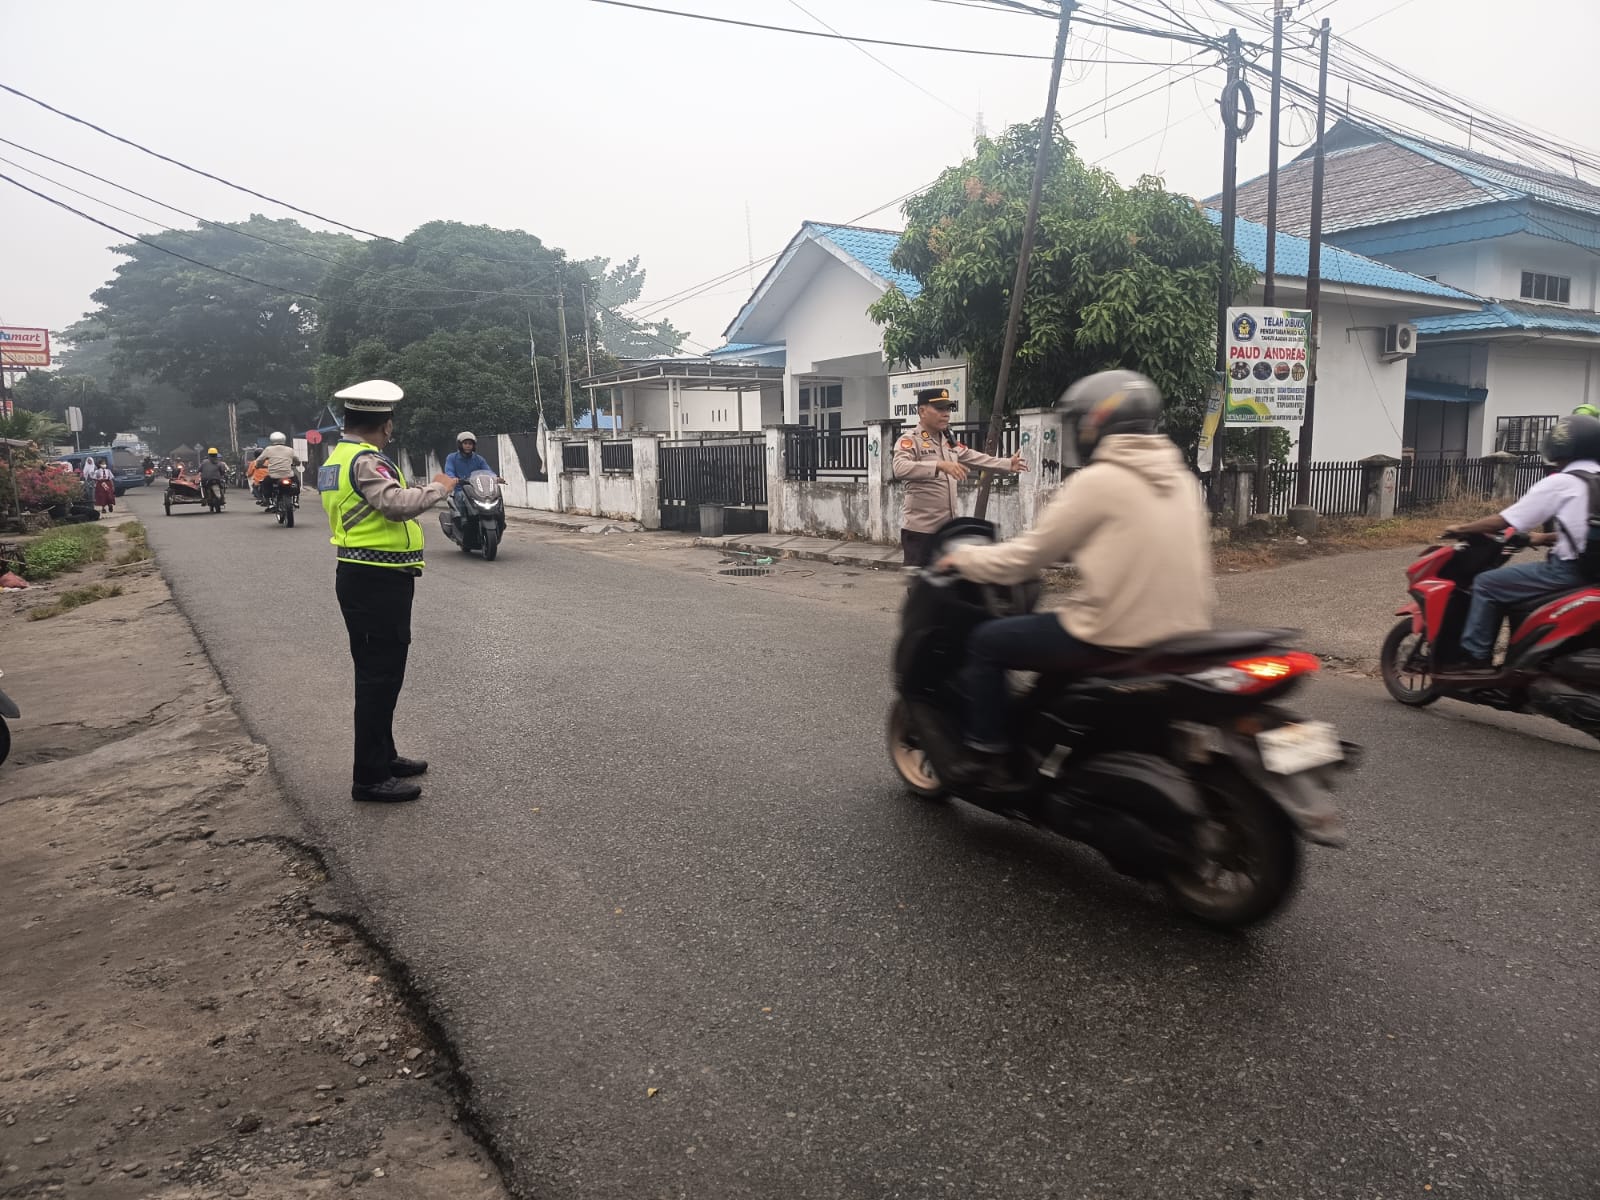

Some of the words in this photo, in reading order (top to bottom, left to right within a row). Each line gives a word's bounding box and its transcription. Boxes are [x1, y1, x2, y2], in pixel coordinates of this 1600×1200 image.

[1264, 317, 1283, 327] TELAH
[1285, 318, 1305, 329] DIBUKA
[1230, 346, 1261, 360] PAUD
[1263, 347, 1306, 361] ANDREAS
